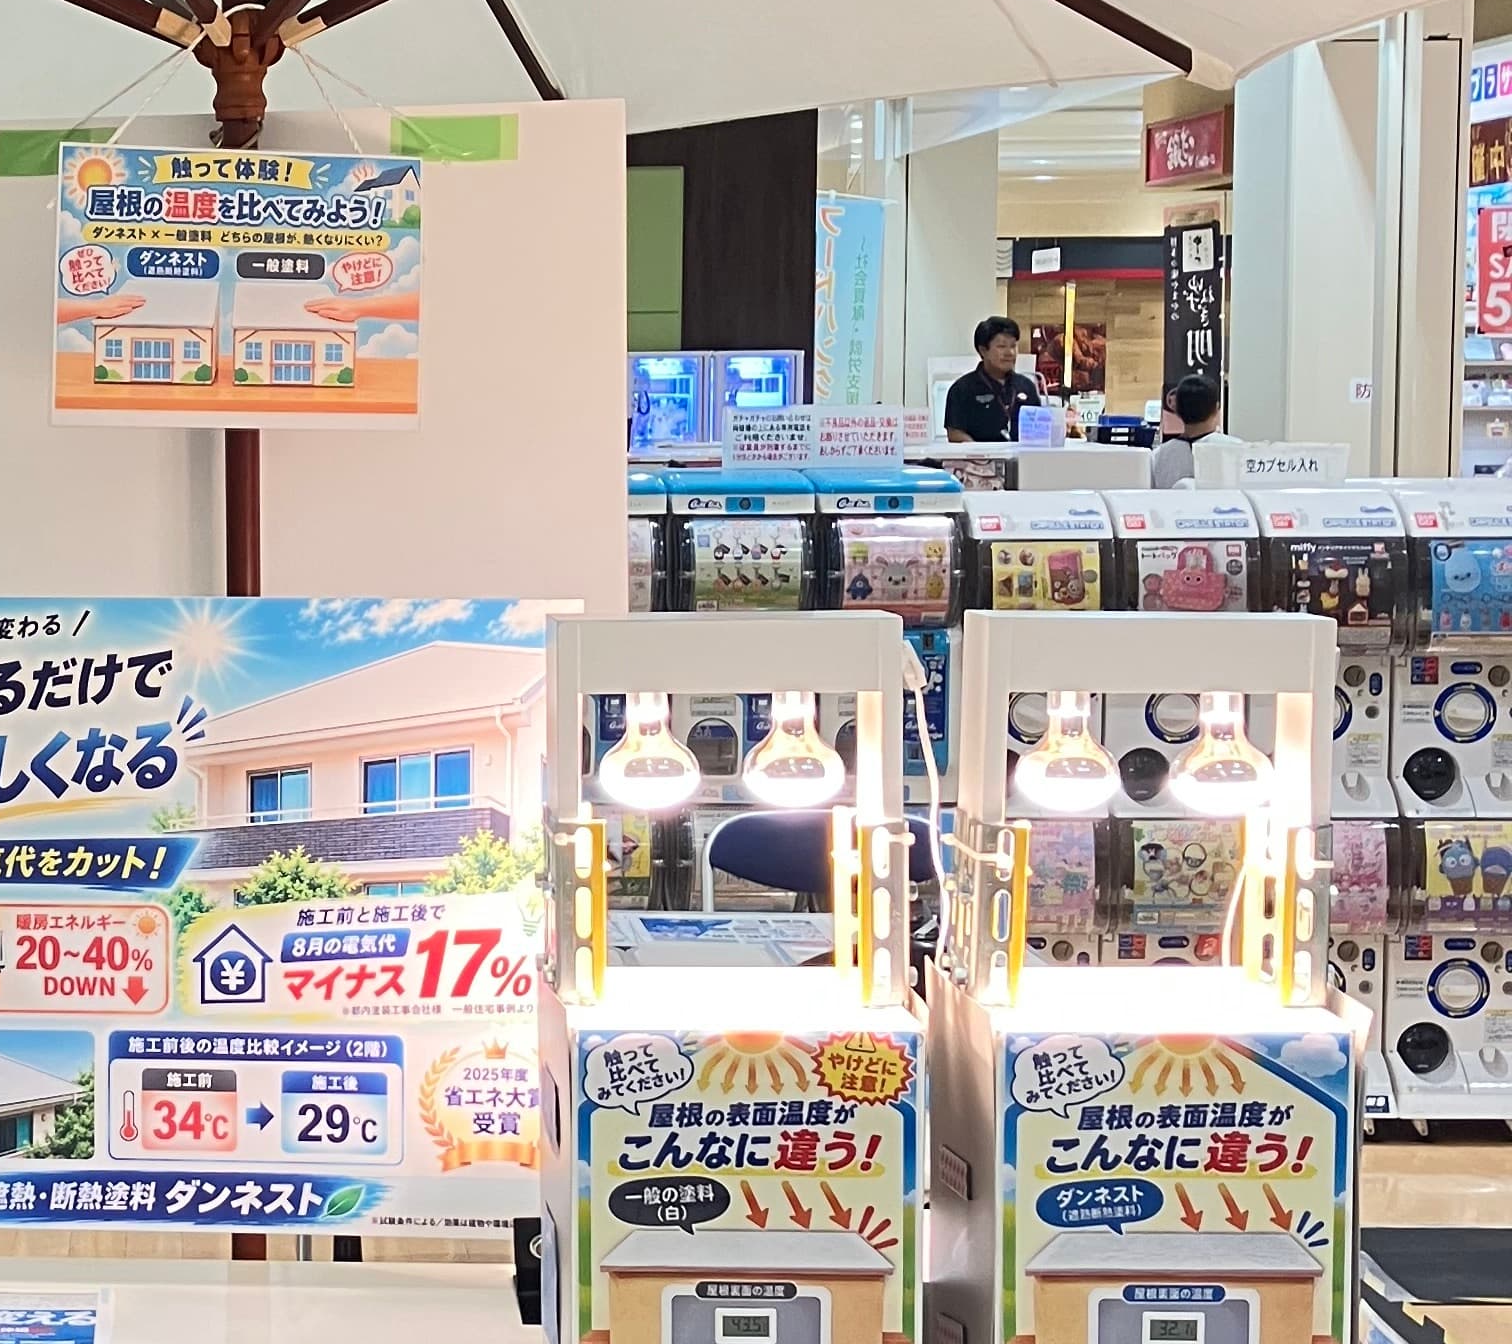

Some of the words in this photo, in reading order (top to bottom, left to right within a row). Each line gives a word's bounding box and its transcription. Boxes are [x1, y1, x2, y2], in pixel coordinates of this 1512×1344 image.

[88, 189, 384, 228] 屋根の温度を比べてみよう！
[139, 251, 208, 266] ダンネスト
[252, 258, 309, 274] 一般塗料
[1246, 457, 1319, 474] 空カプセル入れ
[15, 913, 126, 932] 暖房エネルギー
[297, 903, 446, 928] 施工前と施工後で
[292, 934, 396, 957] 8月の電気代
[283, 965, 406, 1001] マイナス
[416, 928, 532, 1000] 17%
[43, 975, 116, 997] DOWN
[604, 1042, 653, 1065] 触って
[828, 1053, 898, 1076] やけどに
[1032, 1045, 1084, 1070] 触って
[166, 1072, 213, 1089] 施工前
[311, 1074, 359, 1092] 施工後
[463, 1067, 529, 1082] 2025年度
[609, 1060, 660, 1083] 比べて
[1038, 1061, 1089, 1087] 比べて
[473, 1111, 521, 1136] 受賞
[648, 1099, 858, 1128] 屋根の表面温度が
[1078, 1101, 1294, 1131] 屋根の表面温度が
[618, 1130, 883, 1172] こんなに違う！
[1046, 1132, 1314, 1175] こんなに違う！
[165, 1181, 325, 1217] ダンネスト
[625, 1182, 715, 1204] 一般の塗料
[1056, 1184, 1144, 1208] ダンネスト
